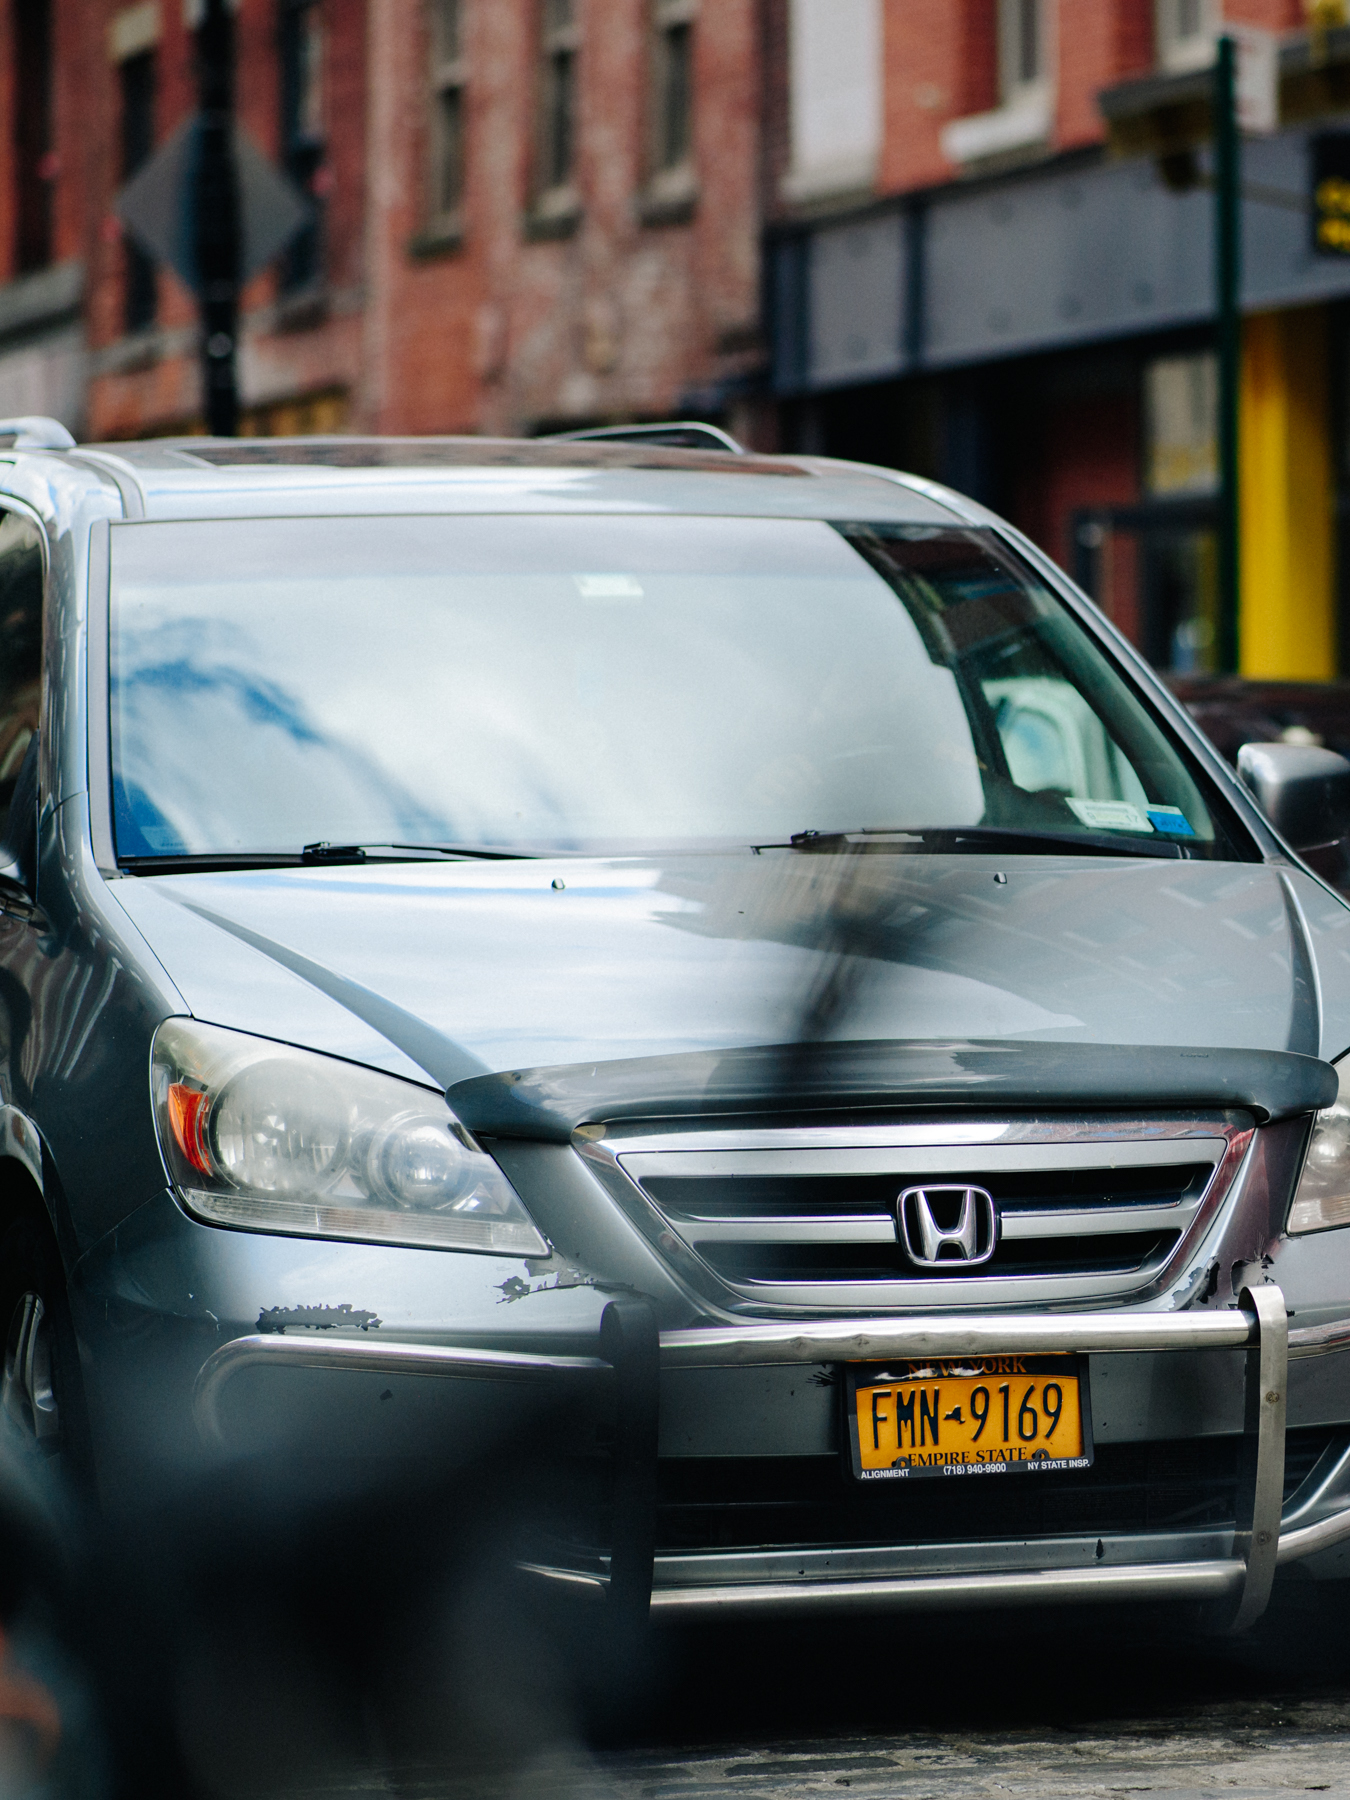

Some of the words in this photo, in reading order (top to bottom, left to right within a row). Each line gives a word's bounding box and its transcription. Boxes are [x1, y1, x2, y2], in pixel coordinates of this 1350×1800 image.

[968, 1356, 1028, 1375] YORK
[908, 1450, 971, 1467] EMPIRE
[975, 1447, 1028, 1463] STATE
[943, 1465, 965, 1476] (718)
[967, 1462, 1007, 1474] 940-9900
[1027, 1462, 1040, 1471] NY
[1041, 1460, 1068, 1470] STATE
[1069, 1458, 1090, 1469] INSP.
[860, 1468, 910, 1479] ALIGNMENT
